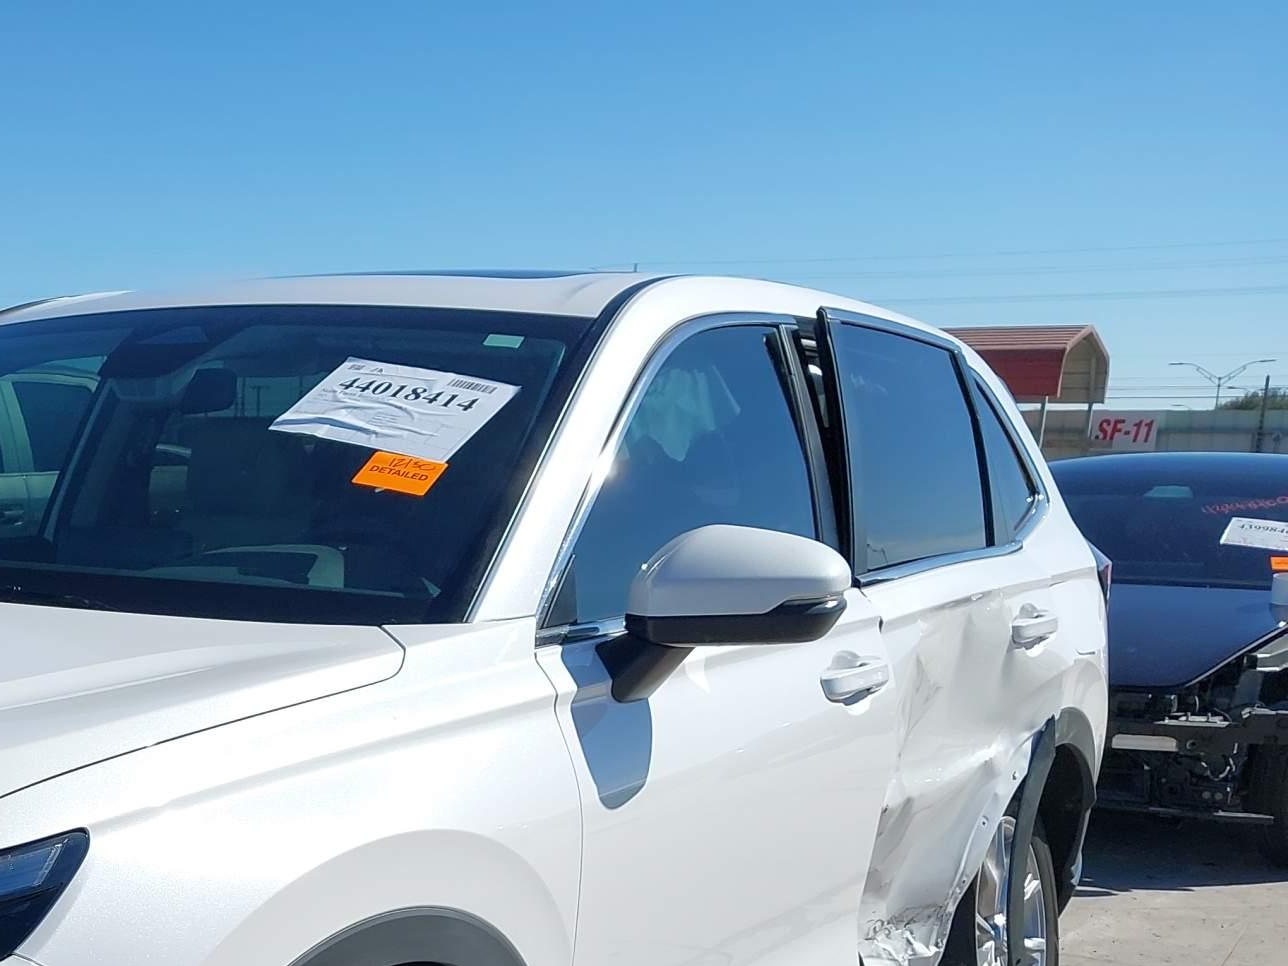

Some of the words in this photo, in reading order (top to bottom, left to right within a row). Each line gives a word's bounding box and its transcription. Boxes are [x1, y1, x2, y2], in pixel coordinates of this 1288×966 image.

[339, 376, 481, 413] 44018414
[1095, 418, 1155, 444] SF-11
[368, 464, 430, 482] DETAILED
